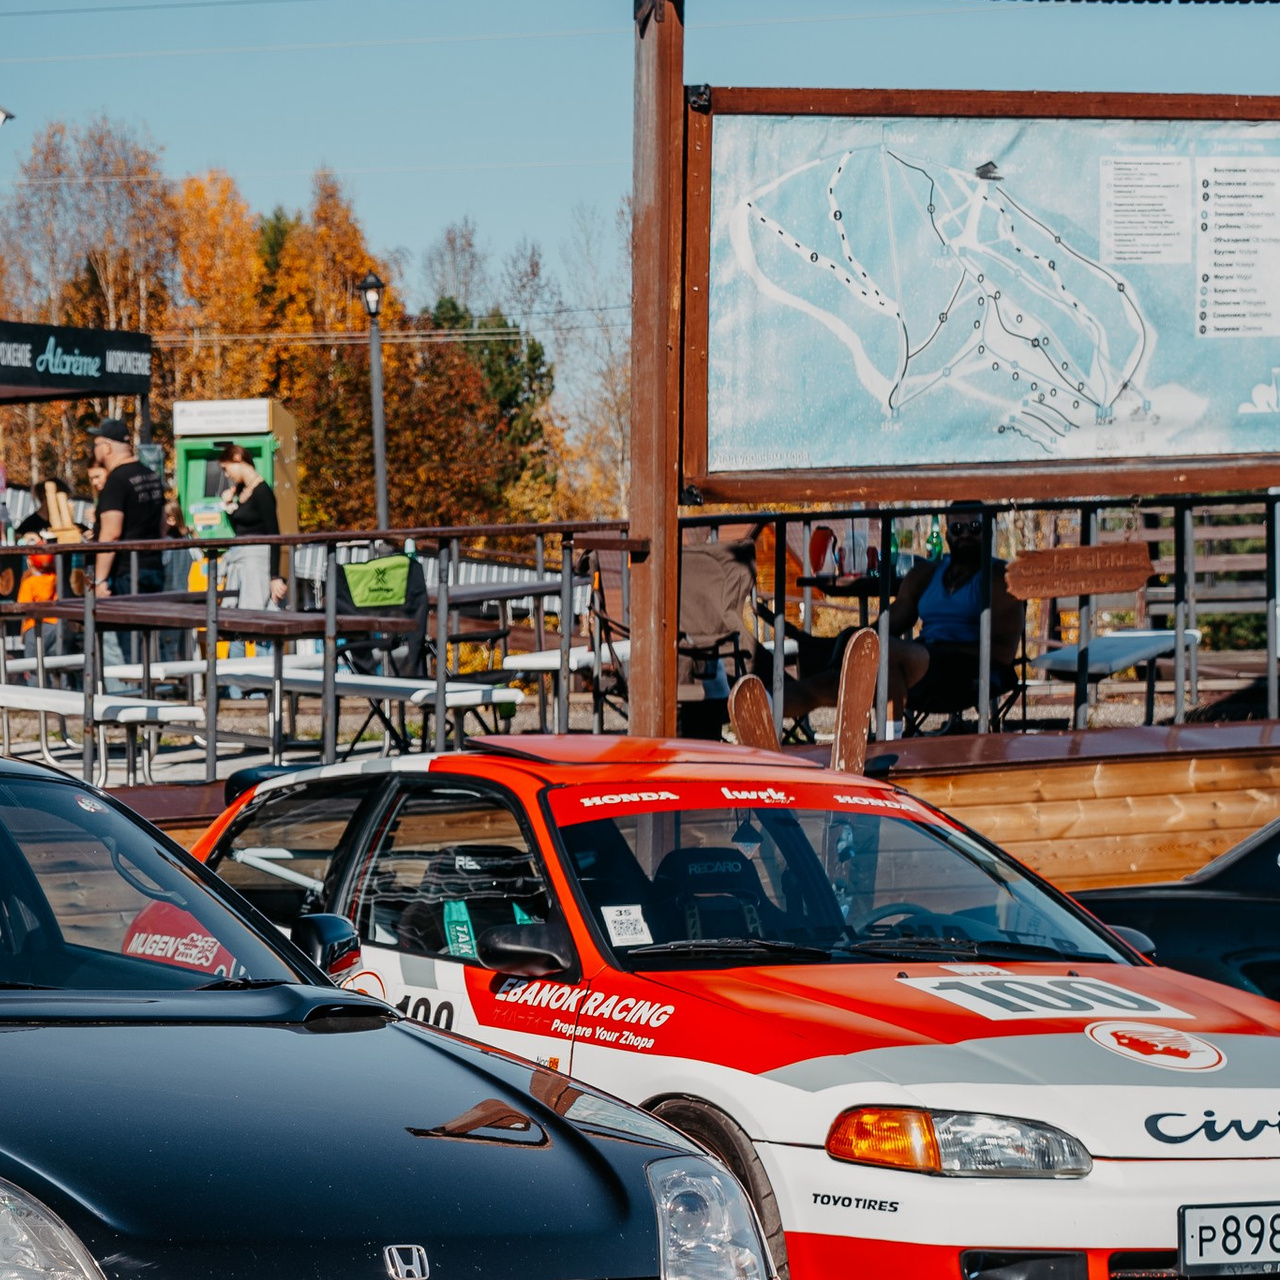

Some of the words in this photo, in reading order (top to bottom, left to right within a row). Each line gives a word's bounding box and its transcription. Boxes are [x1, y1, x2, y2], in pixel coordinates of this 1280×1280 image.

[580, 791, 680, 807] HONDA
[833, 794, 919, 813] HONDA
[688, 861, 742, 876] RECARO
[126, 932, 178, 959] MUGEN
[579, 989, 676, 1028] RACING
[930, 979, 1162, 1014] 100
[550, 1018, 593, 1039] Prepare
[594, 1025, 620, 1043] Your
[618, 1030, 655, 1051] Zhopa
[1144, 1109, 1280, 1144] Civ
[812, 1192, 853, 1208] TOYO
[853, 1197, 900, 1213] TIRES
